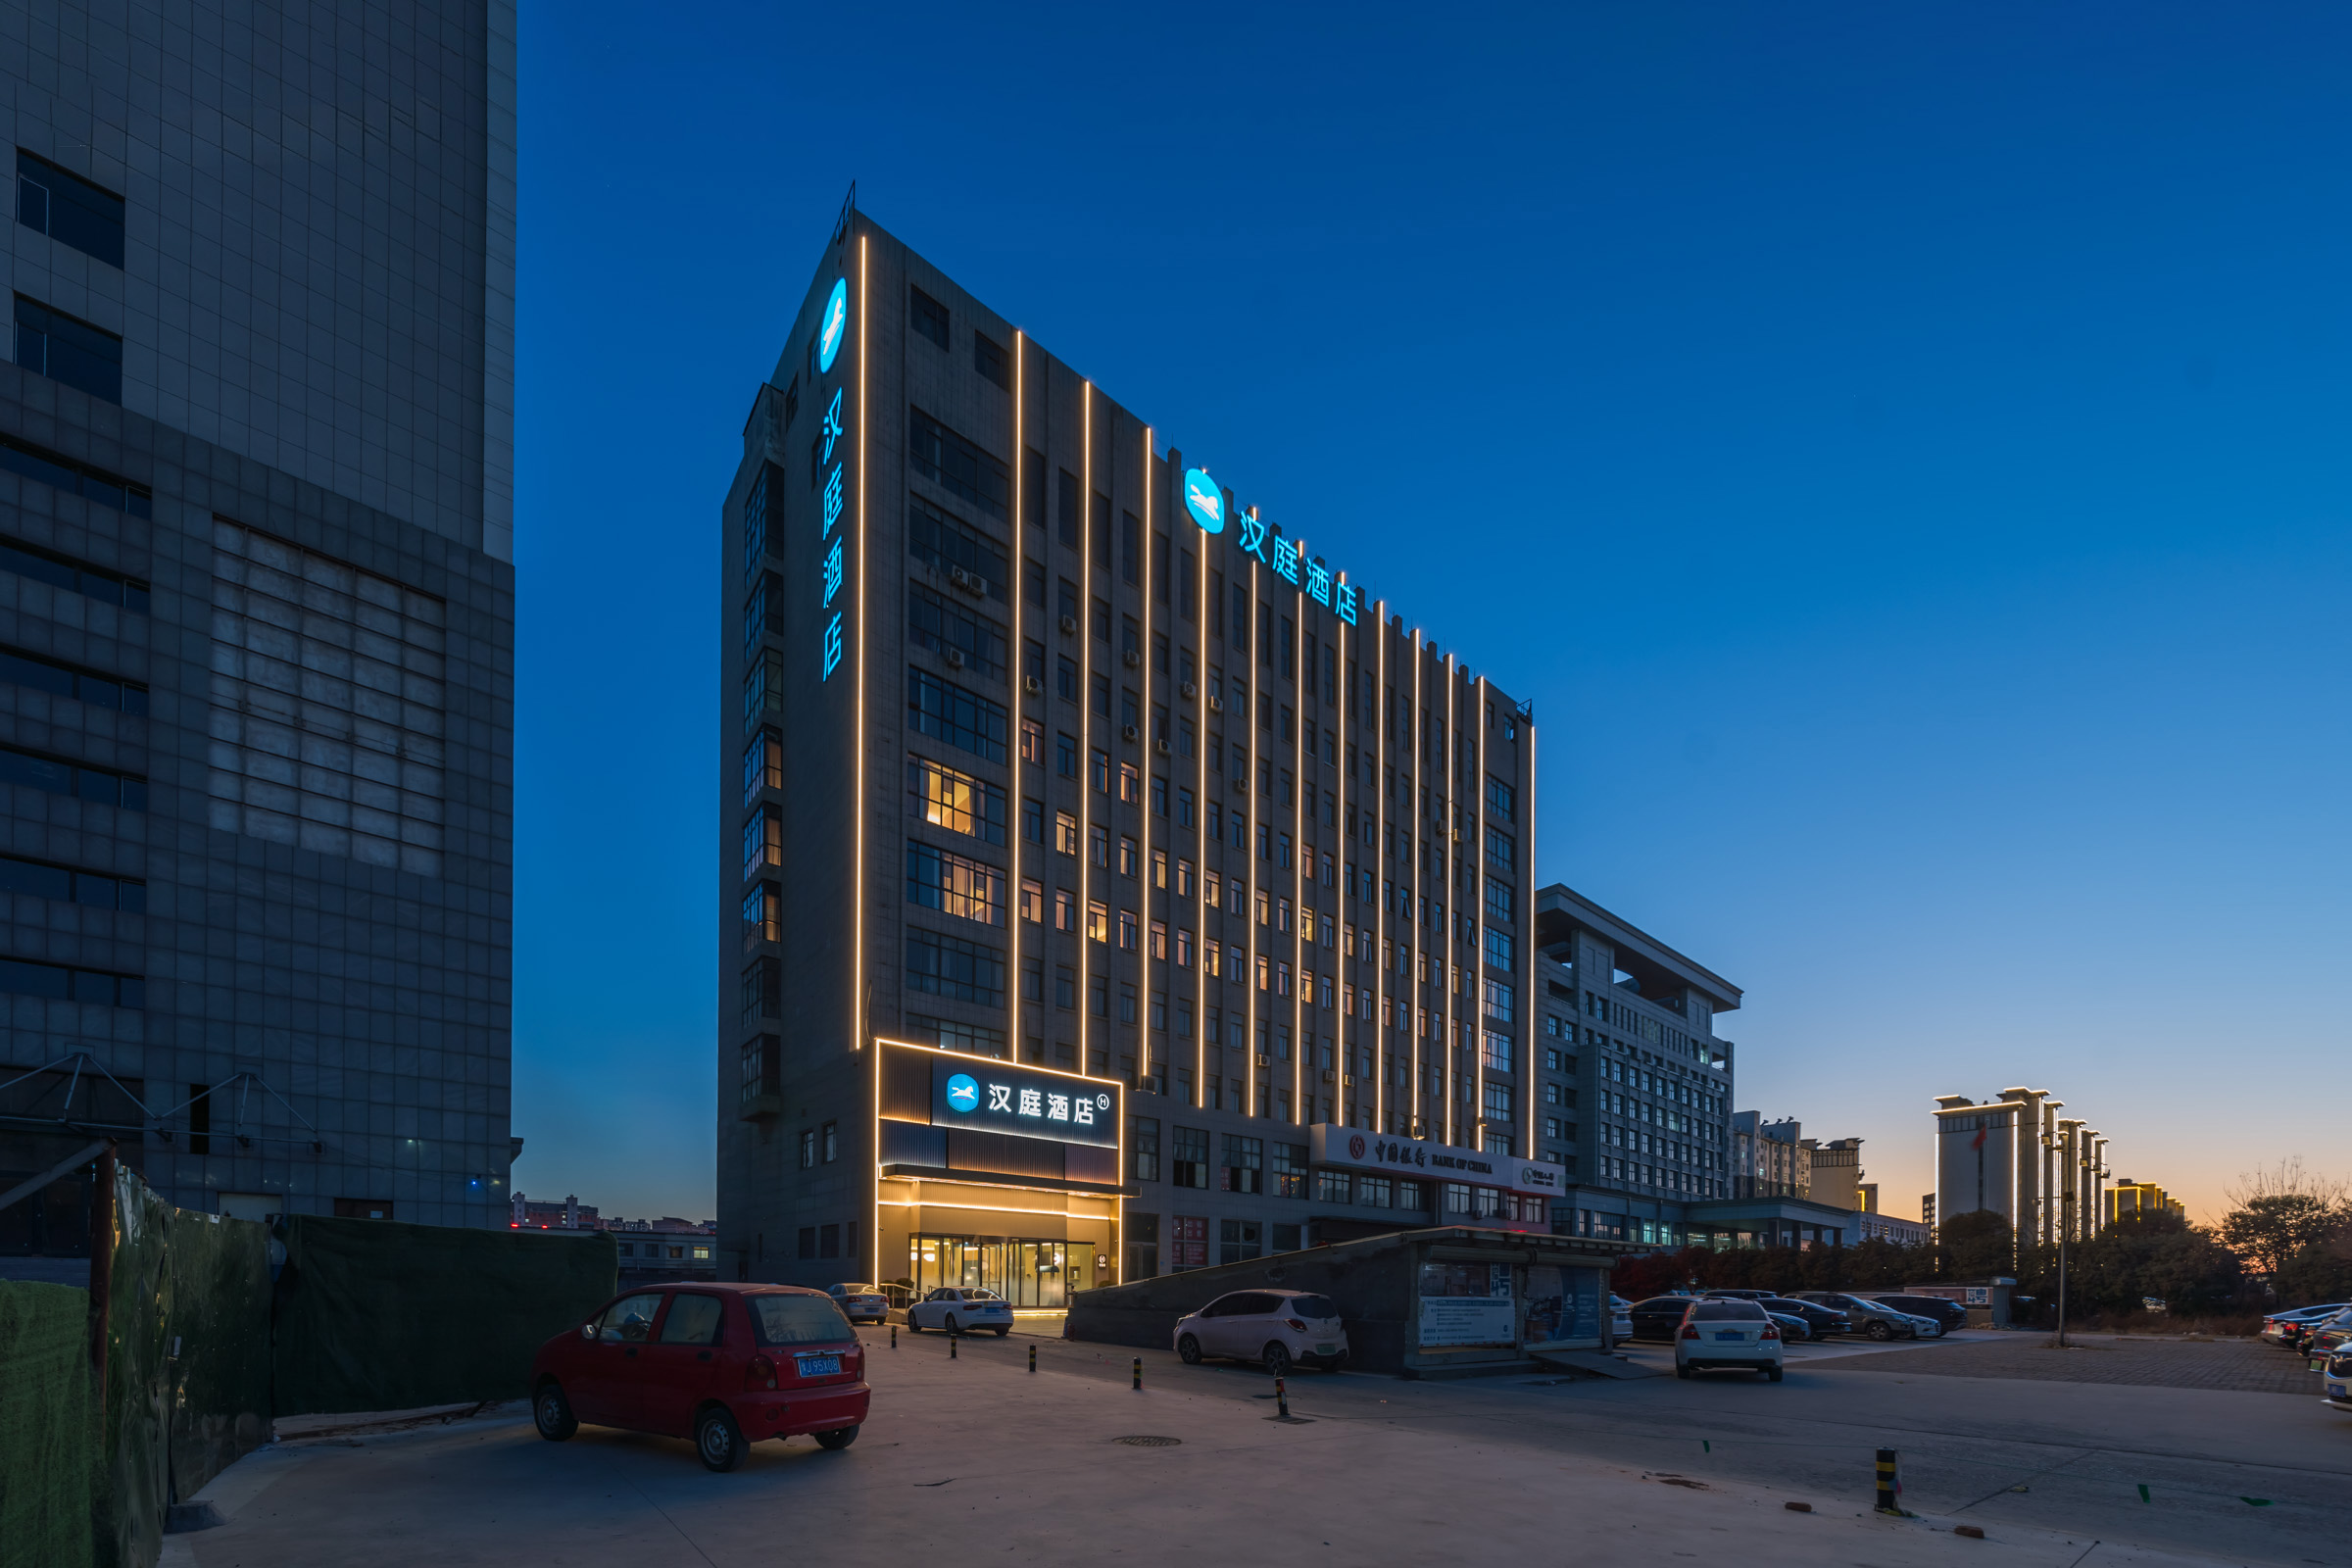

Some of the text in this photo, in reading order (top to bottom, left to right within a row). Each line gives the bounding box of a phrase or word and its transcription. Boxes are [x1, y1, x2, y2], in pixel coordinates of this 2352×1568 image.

[821, 387, 845, 683] 汉庭酒店
[1239, 508, 1357, 627] 汉庭酒店
[988, 1083, 1094, 1125] 汉庭酒店
[1375, 1140, 1427, 1167] 中国银行
[1432, 1153, 1493, 1174] BANK OF CHINA
